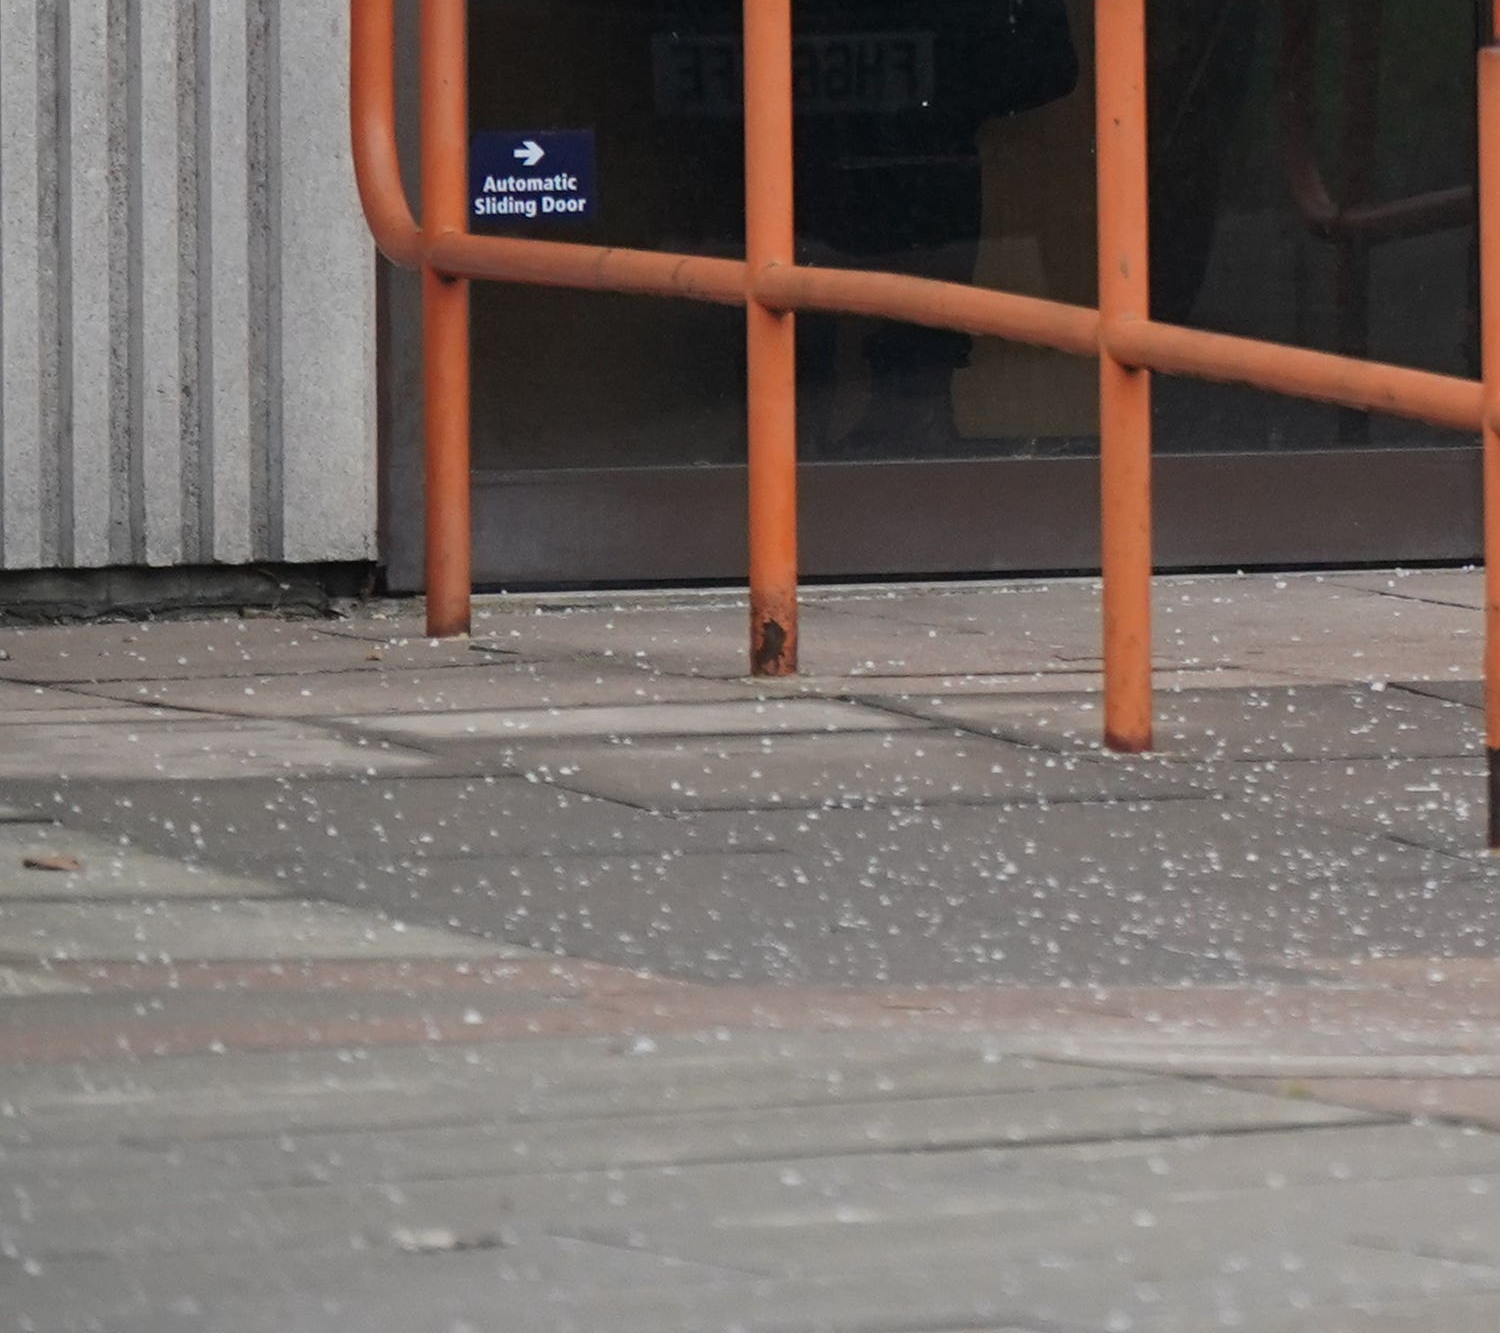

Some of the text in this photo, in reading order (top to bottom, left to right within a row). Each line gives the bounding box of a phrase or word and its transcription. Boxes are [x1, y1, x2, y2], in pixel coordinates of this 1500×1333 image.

[483, 172, 577, 193] Automatic
[475, 190, 587, 218] Sliding Door
